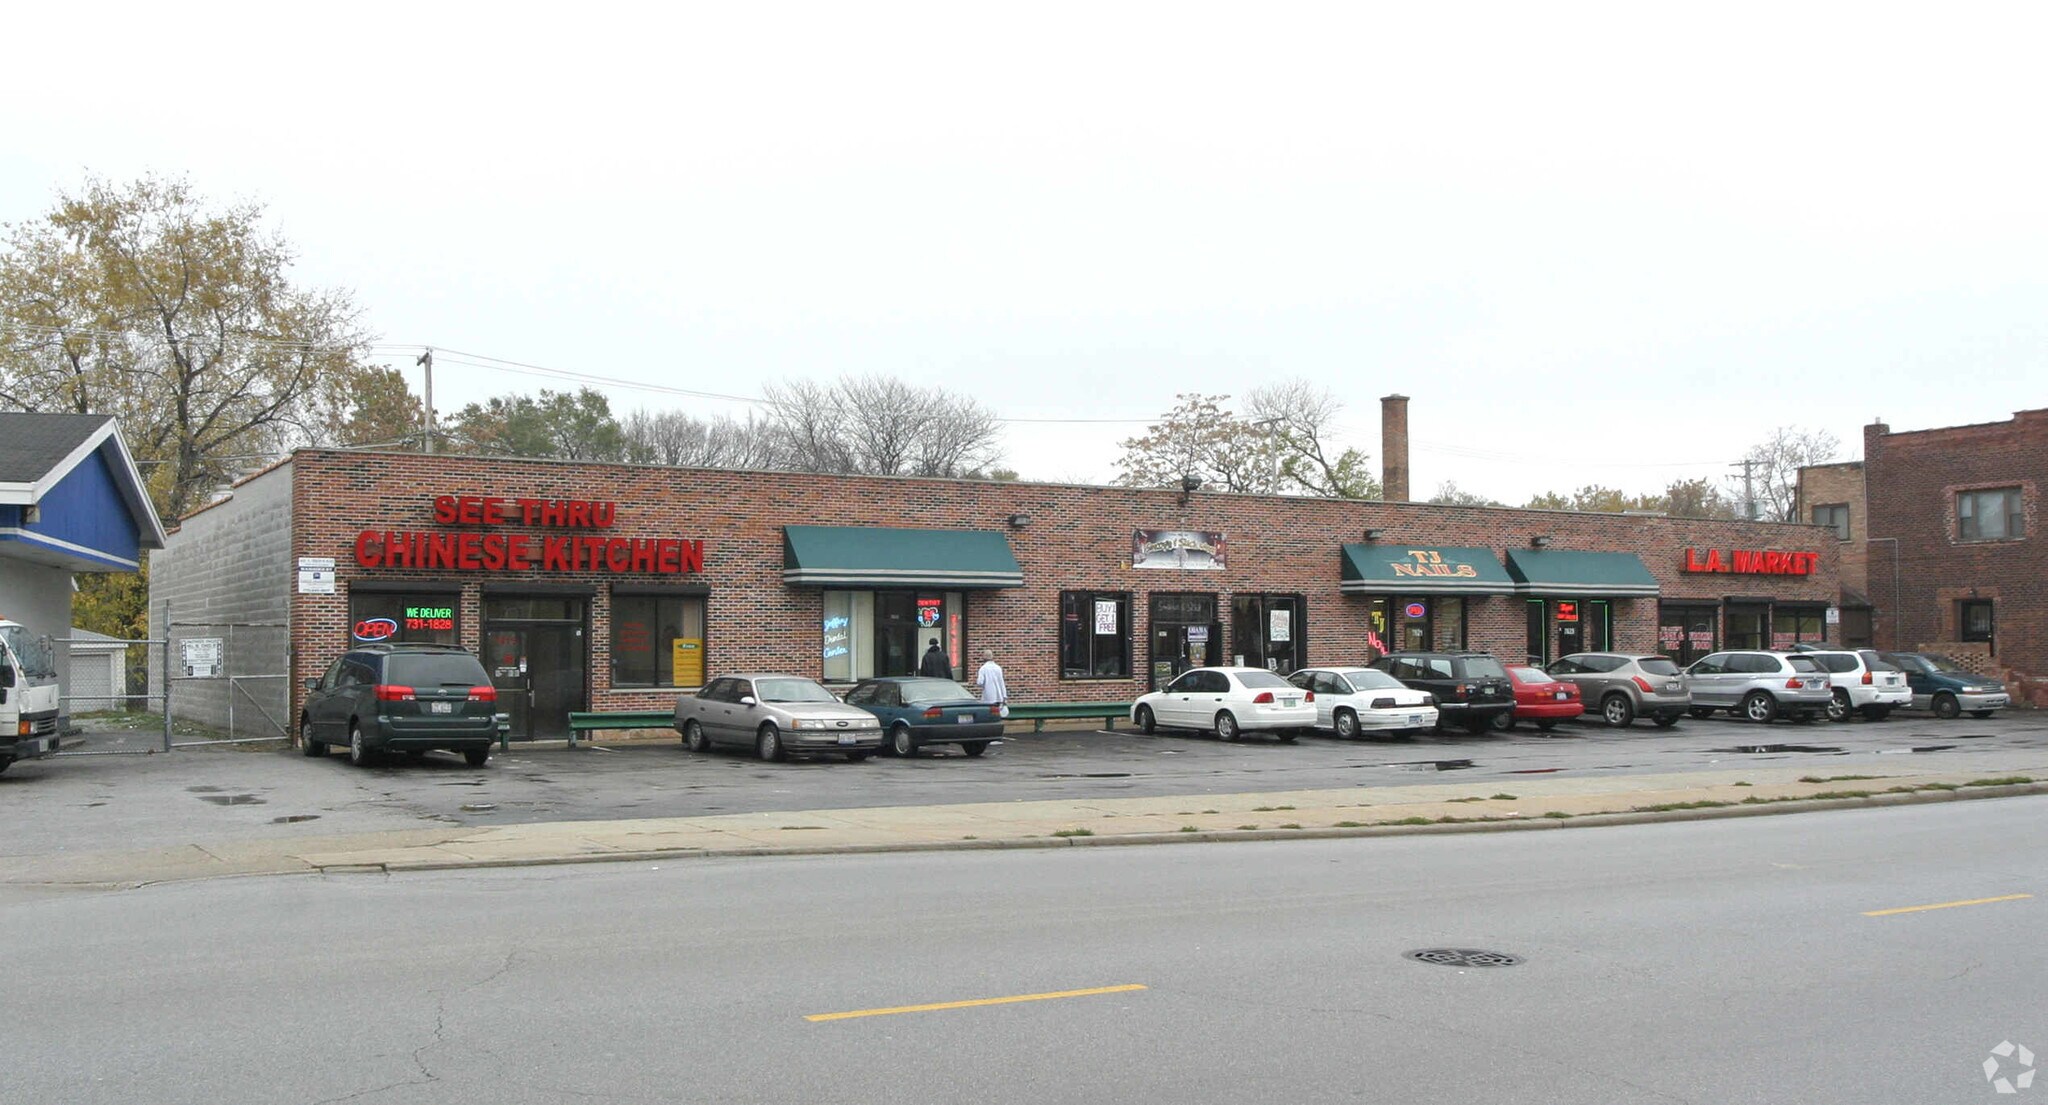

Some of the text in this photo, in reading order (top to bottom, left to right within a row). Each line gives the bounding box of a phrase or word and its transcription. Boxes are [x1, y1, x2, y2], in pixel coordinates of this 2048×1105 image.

[434, 495, 616, 528] SEE THRU
[355, 530, 704, 574] CHINESE KITCHEN
[1407, 550, 1441, 563] TJ
[1686, 547, 1819, 575] L.A. MARKET
[1390, 563, 1477, 578] NAILS
[406, 607, 452, 618] WE DELIVER
[354, 621, 394, 638] OPEN
[406, 619, 452, 630] 731-1828
[1099, 623, 1117, 632] FREE
